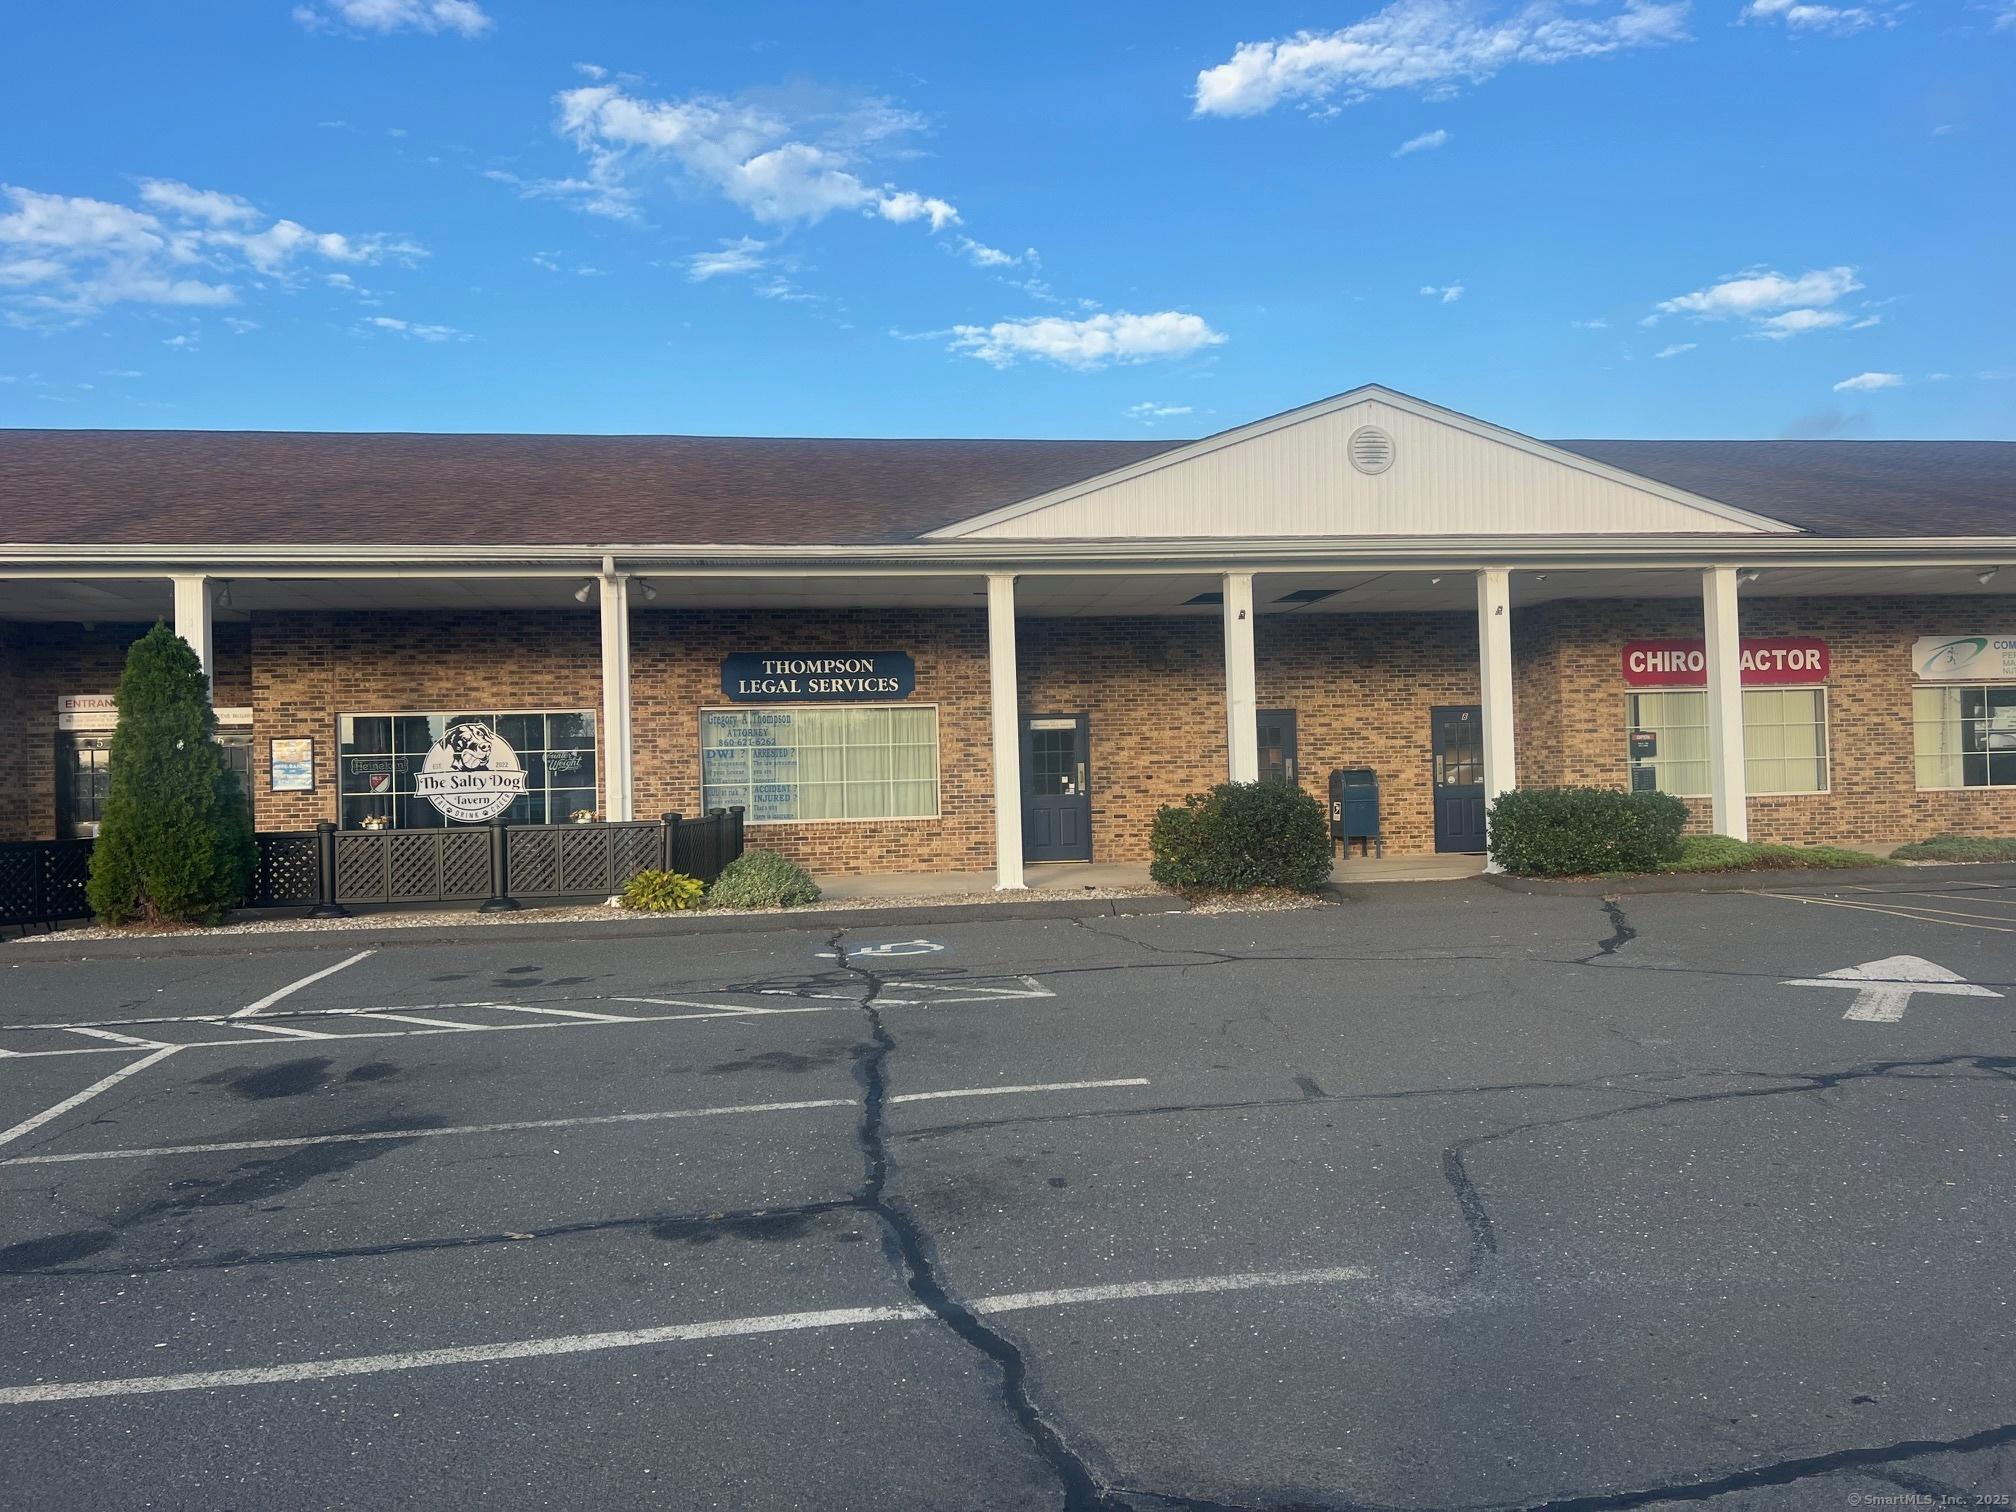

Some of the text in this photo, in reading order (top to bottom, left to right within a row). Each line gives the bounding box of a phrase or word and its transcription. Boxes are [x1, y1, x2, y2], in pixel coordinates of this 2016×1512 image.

[1629, 649, 1821, 673] CHIROACTOR
[762, 659, 875, 675] THOMPSON
[738, 677, 899, 694] LEGAL SERVICES
[65, 699, 113, 709] ENTRAN
[707, 713, 738, 728] Gregory
[751, 712, 791, 727] Thompson
[727, 728, 769, 737] ATTORNEY
[96, 737, 104, 748] 5
[706, 748, 735, 759] DWI
[355, 761, 404, 771] Heinekn
[420, 774, 521, 790] The Salty Dog
[754, 784, 791, 793] ACCIDENT
[454, 796, 490, 805] Tavern
[753, 794, 791, 803] INJURED
[455, 809, 479, 819] DRINK
[490, 793, 511, 813] CHEER
